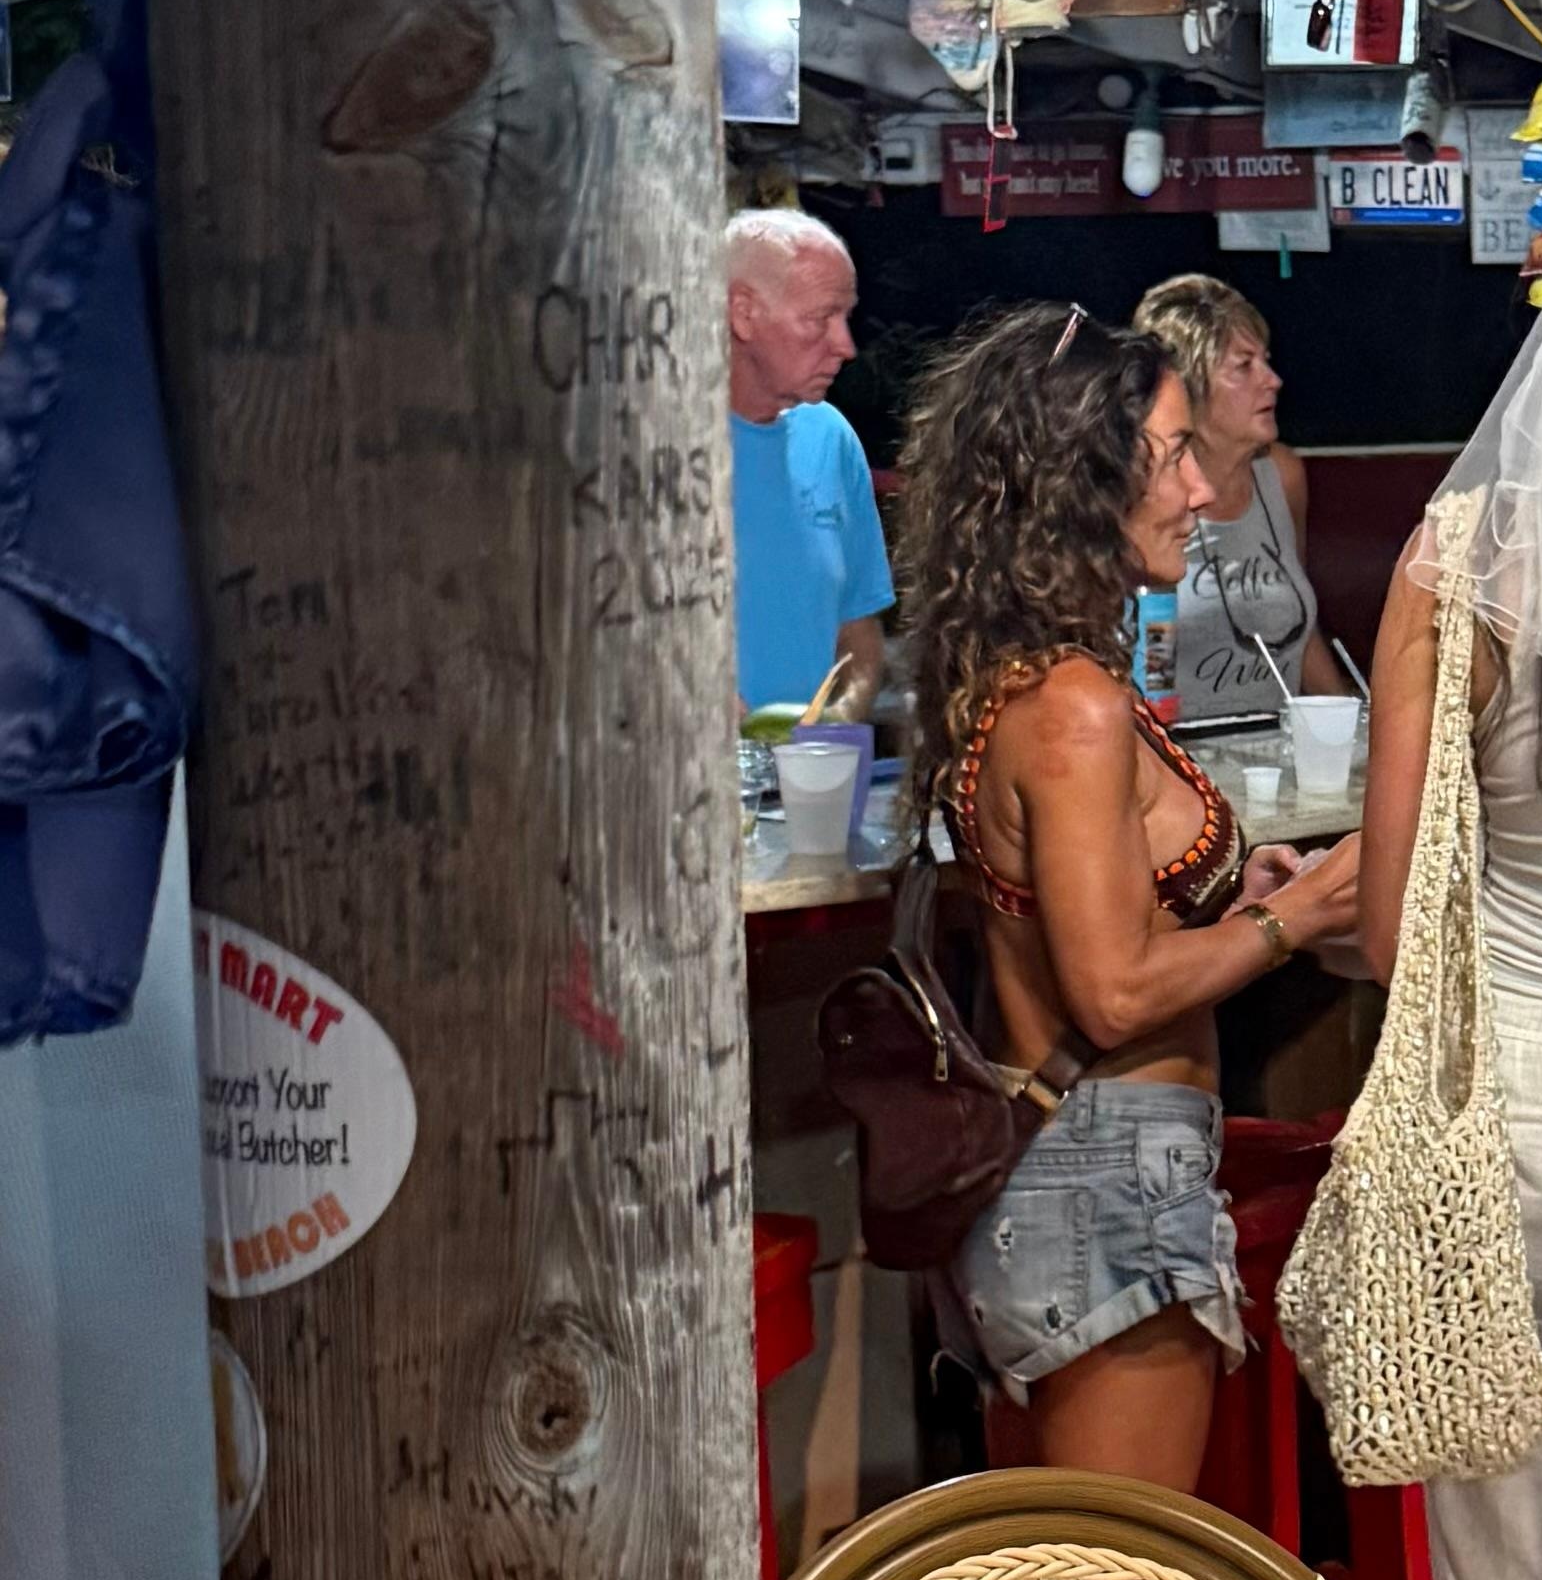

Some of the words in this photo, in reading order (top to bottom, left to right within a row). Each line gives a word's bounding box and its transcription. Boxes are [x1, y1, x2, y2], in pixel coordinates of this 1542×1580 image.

[1189, 157, 1232, 187] you
[1235, 152, 1302, 179] more.
[1341, 174, 1356, 205] B
[1373, 173, 1452, 207] CLEAN
[1192, 552, 1290, 600] Coffee
[219, 939, 344, 1046] MART
[268, 1066, 332, 1114] Your
[237, 1119, 351, 1169] Butcher!
